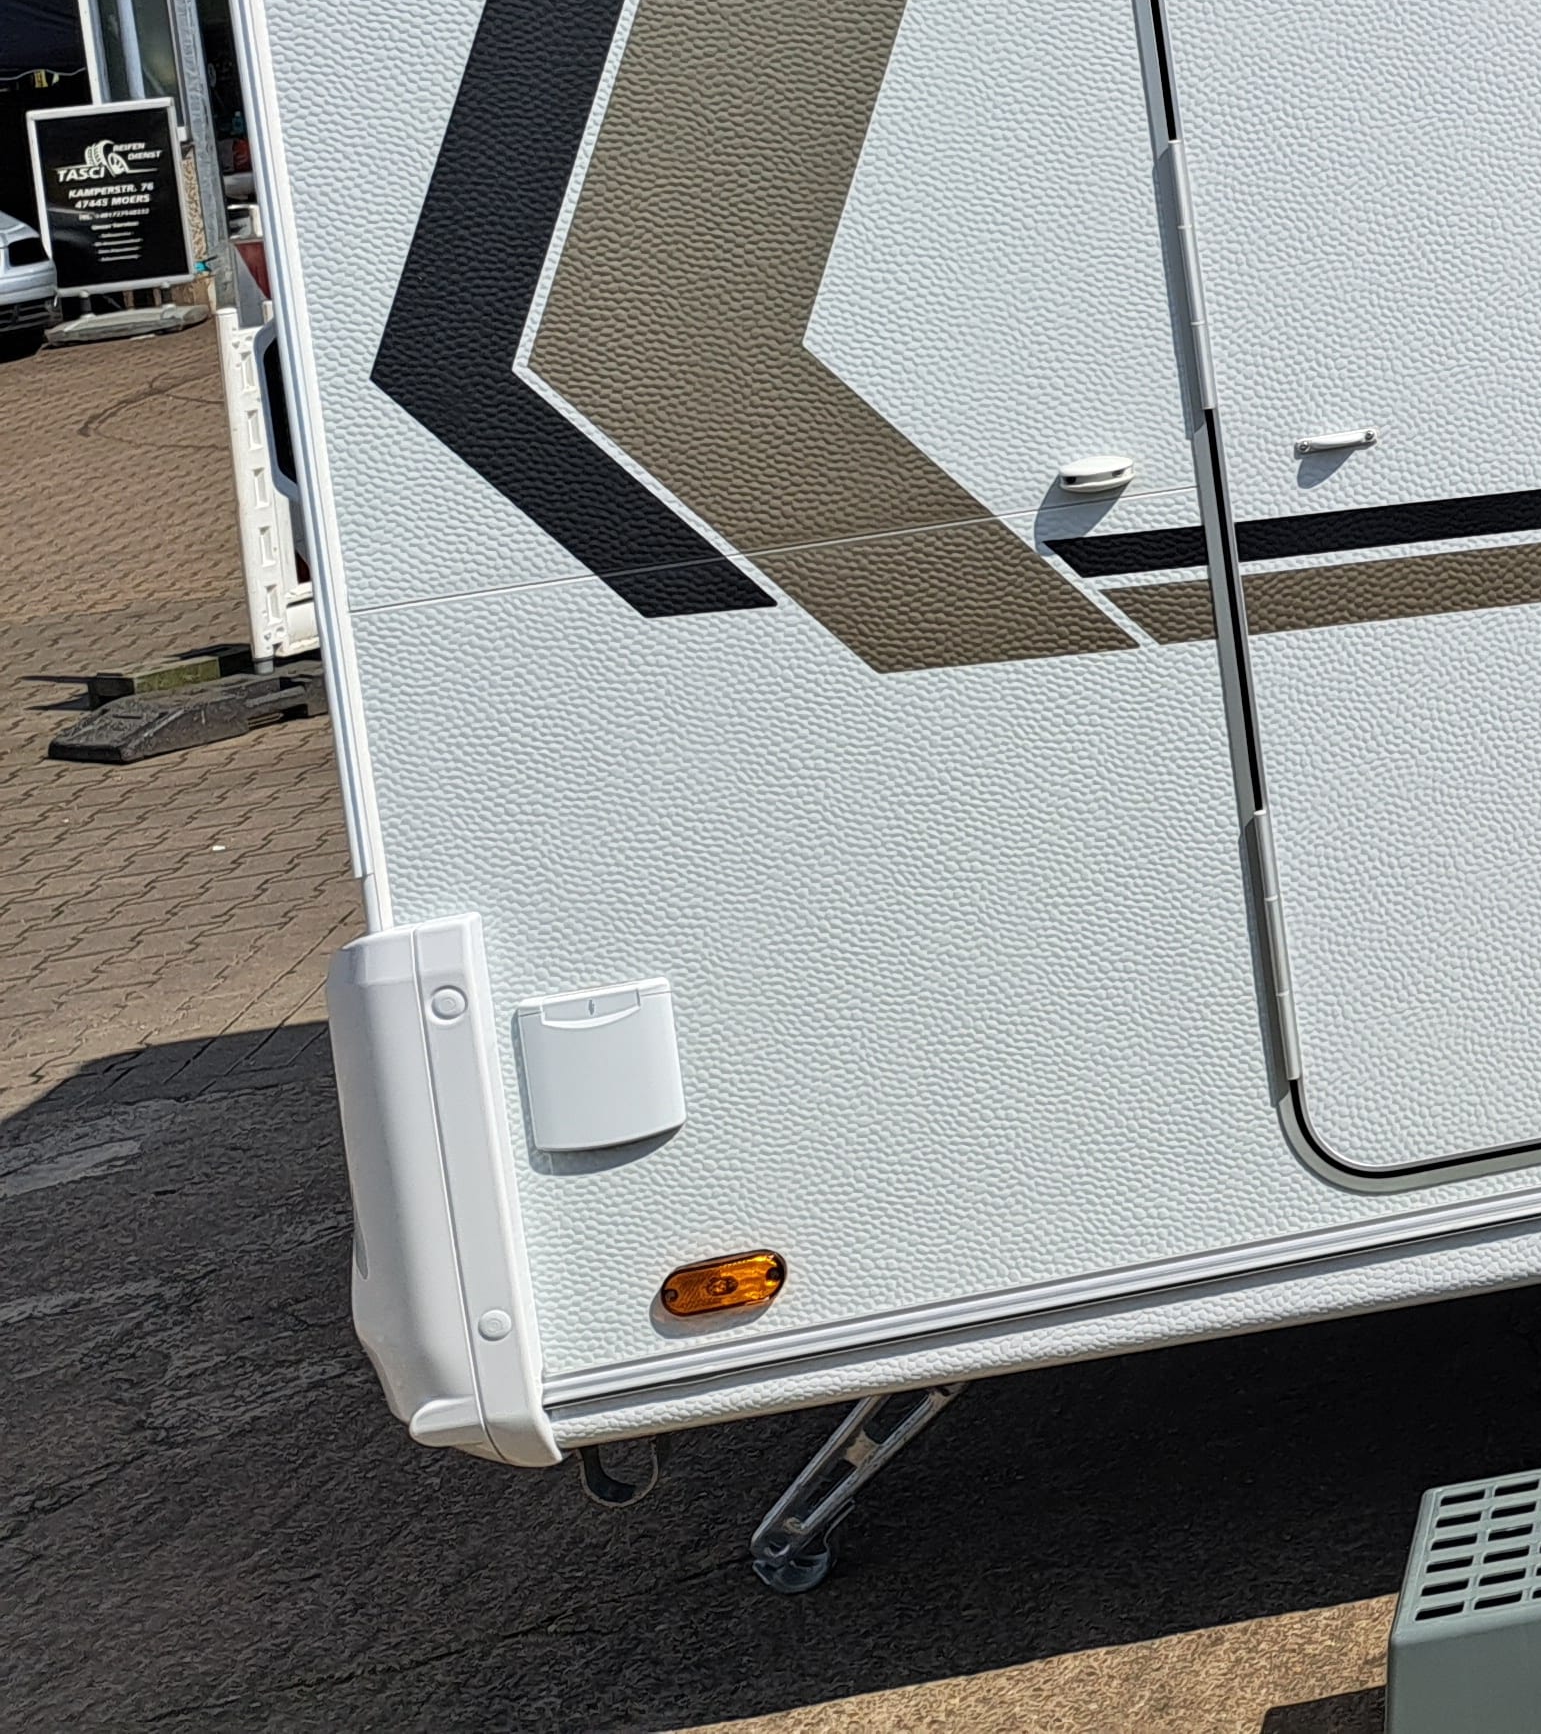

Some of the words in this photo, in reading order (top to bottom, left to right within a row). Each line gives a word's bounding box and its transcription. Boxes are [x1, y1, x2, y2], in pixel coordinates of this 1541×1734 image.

[112, 142, 146, 153] REIFEN
[128, 150, 162, 161] DIENST
[57, 166, 105, 183] TASCI
[111, 194, 150, 206] MOERS
